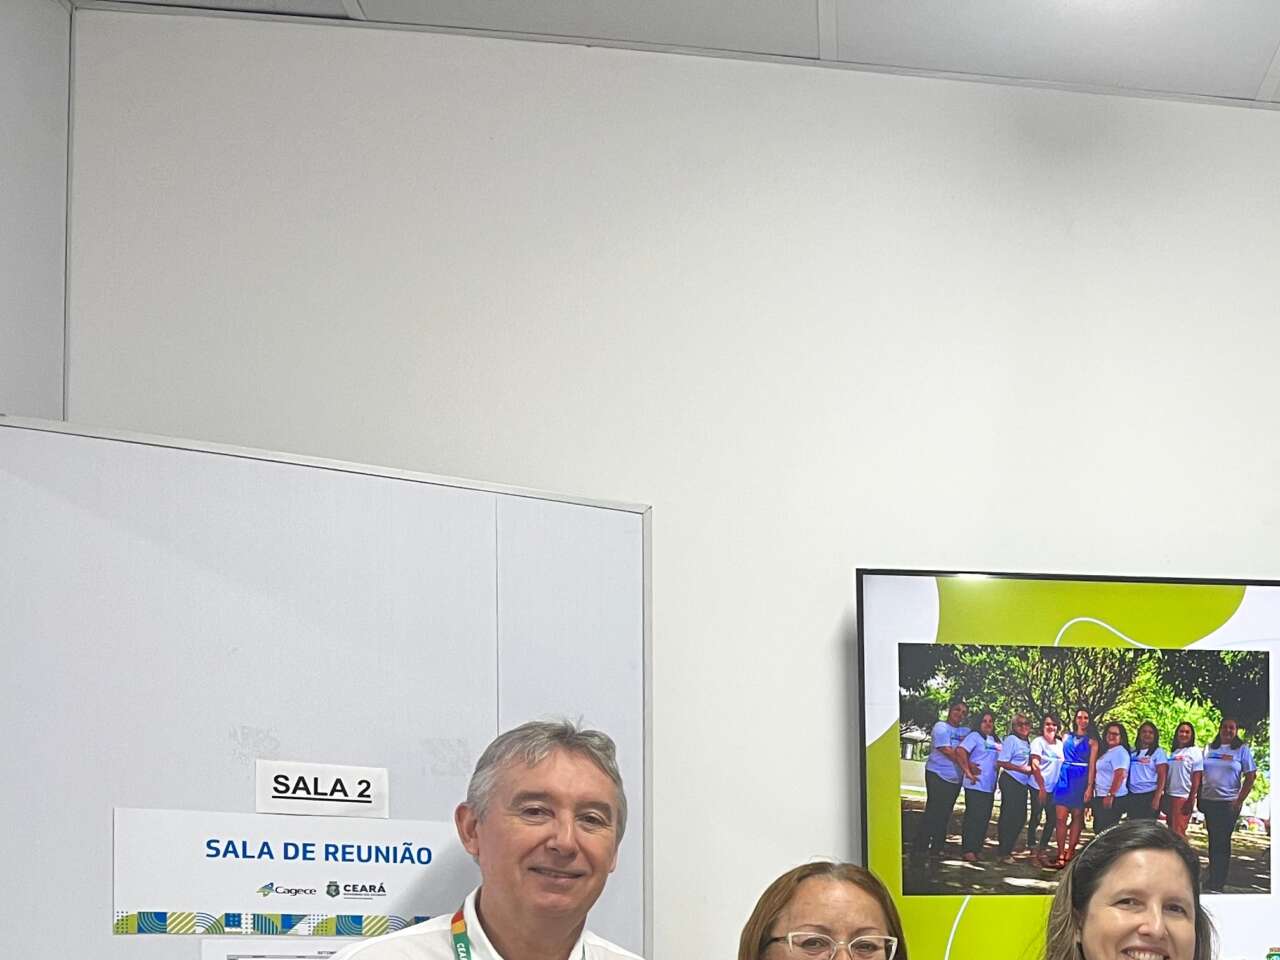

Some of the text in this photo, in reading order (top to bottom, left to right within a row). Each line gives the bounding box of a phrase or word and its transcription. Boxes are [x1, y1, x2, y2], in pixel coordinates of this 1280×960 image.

[272, 774, 372, 799] SALA 2
[205, 839, 432, 865] SALA DE REUNIÃO
[275, 886, 317, 897] Cagece
[343, 882, 387, 893] CEARÁ
